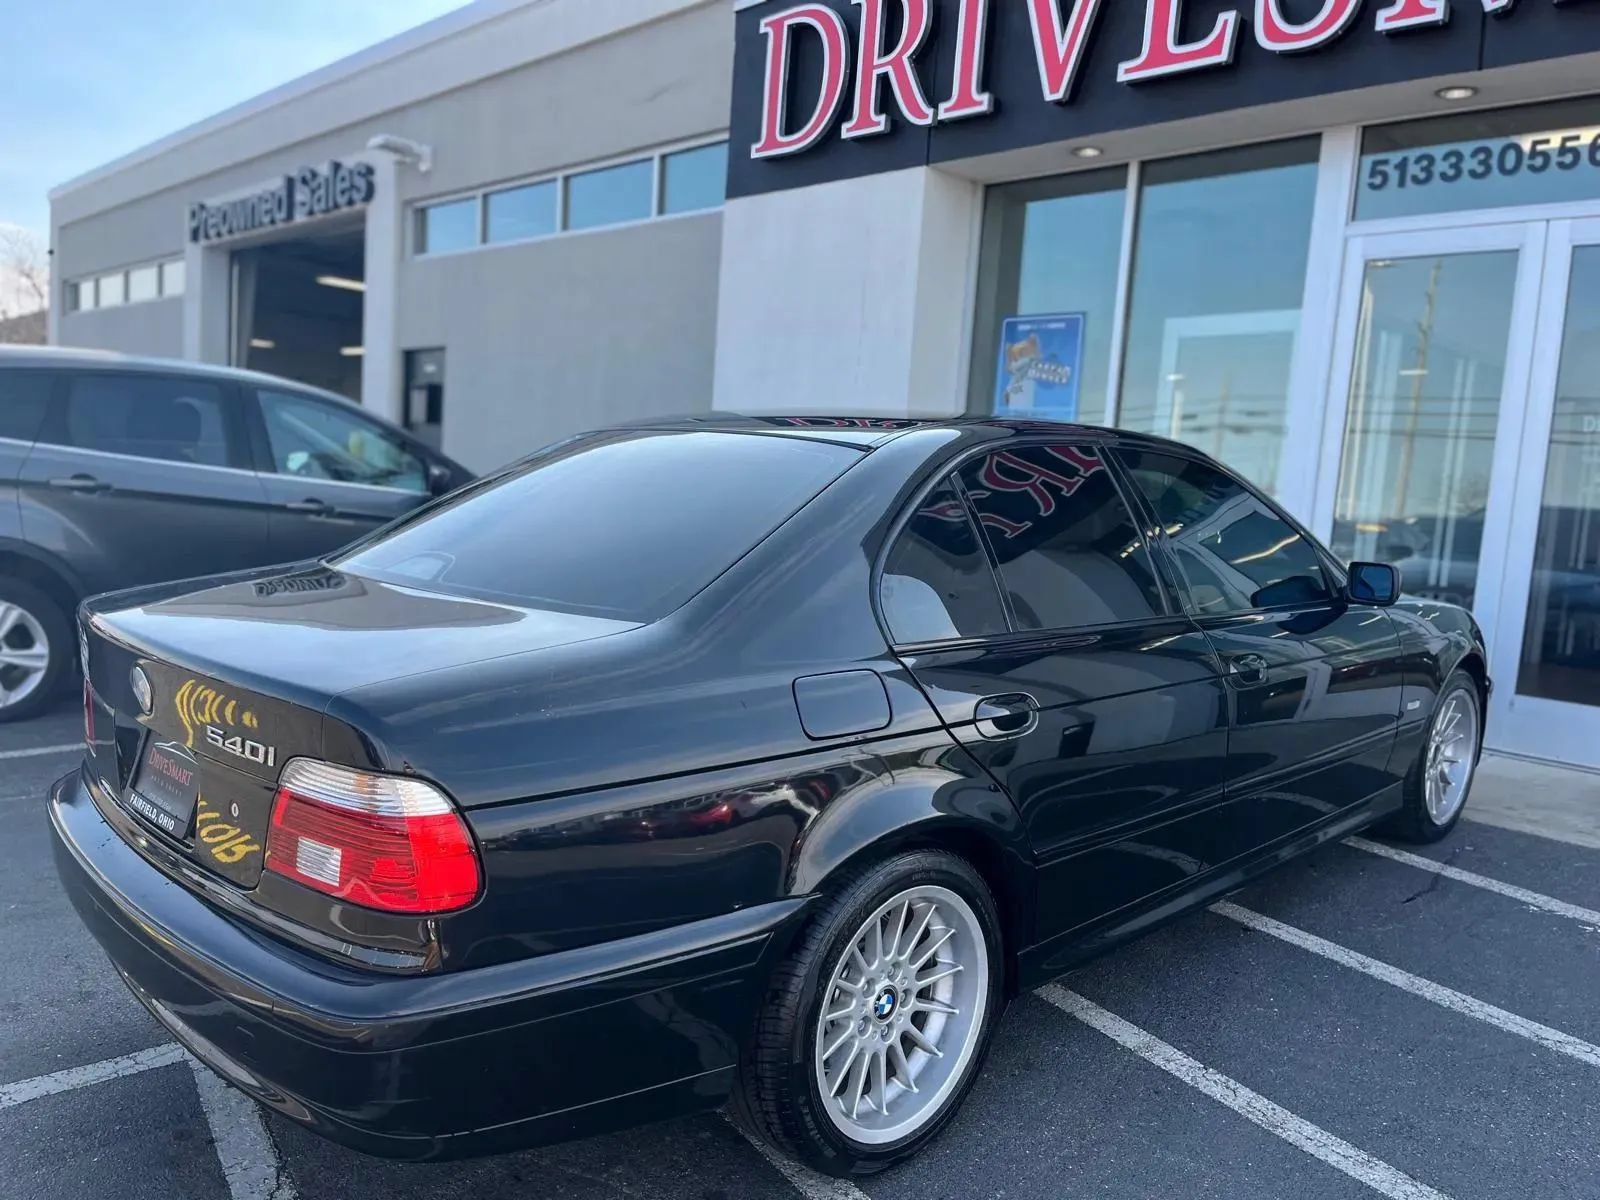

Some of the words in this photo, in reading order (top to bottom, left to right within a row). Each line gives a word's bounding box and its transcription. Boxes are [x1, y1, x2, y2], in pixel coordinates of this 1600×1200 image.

[297, 159, 375, 218] Sales
[129, 793, 157, 823] FAIRFIELD,
[158, 813, 175, 831] OHIO
